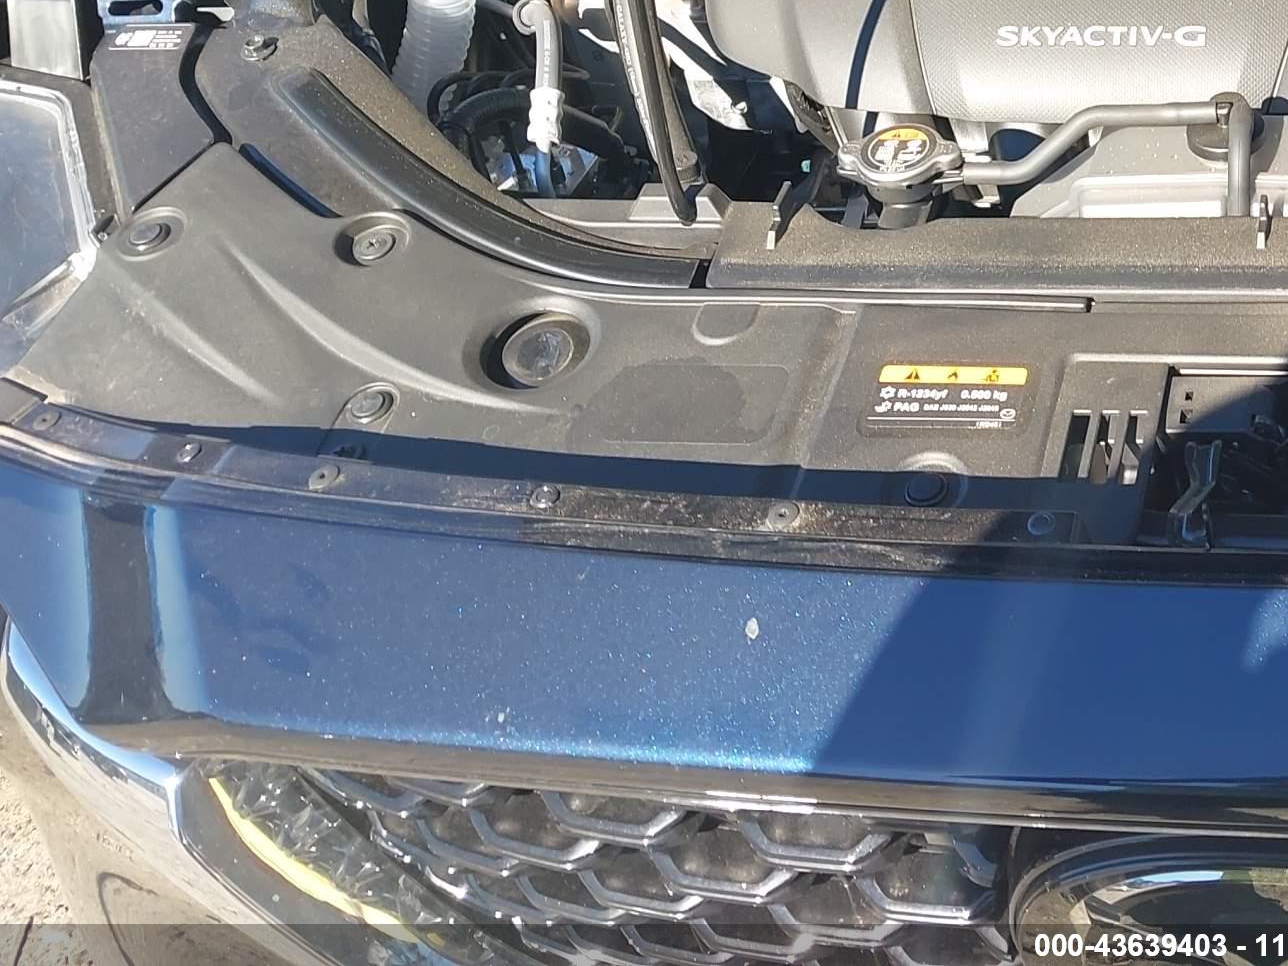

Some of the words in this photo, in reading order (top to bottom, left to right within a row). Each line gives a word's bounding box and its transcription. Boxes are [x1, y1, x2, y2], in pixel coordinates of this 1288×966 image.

[996, 25, 1207, 48] SKYACTIV-G
[897, 389, 948, 401] R-1234yf
[993, 390, 1008, 402] kg
[894, 402, 919, 412] PAG
